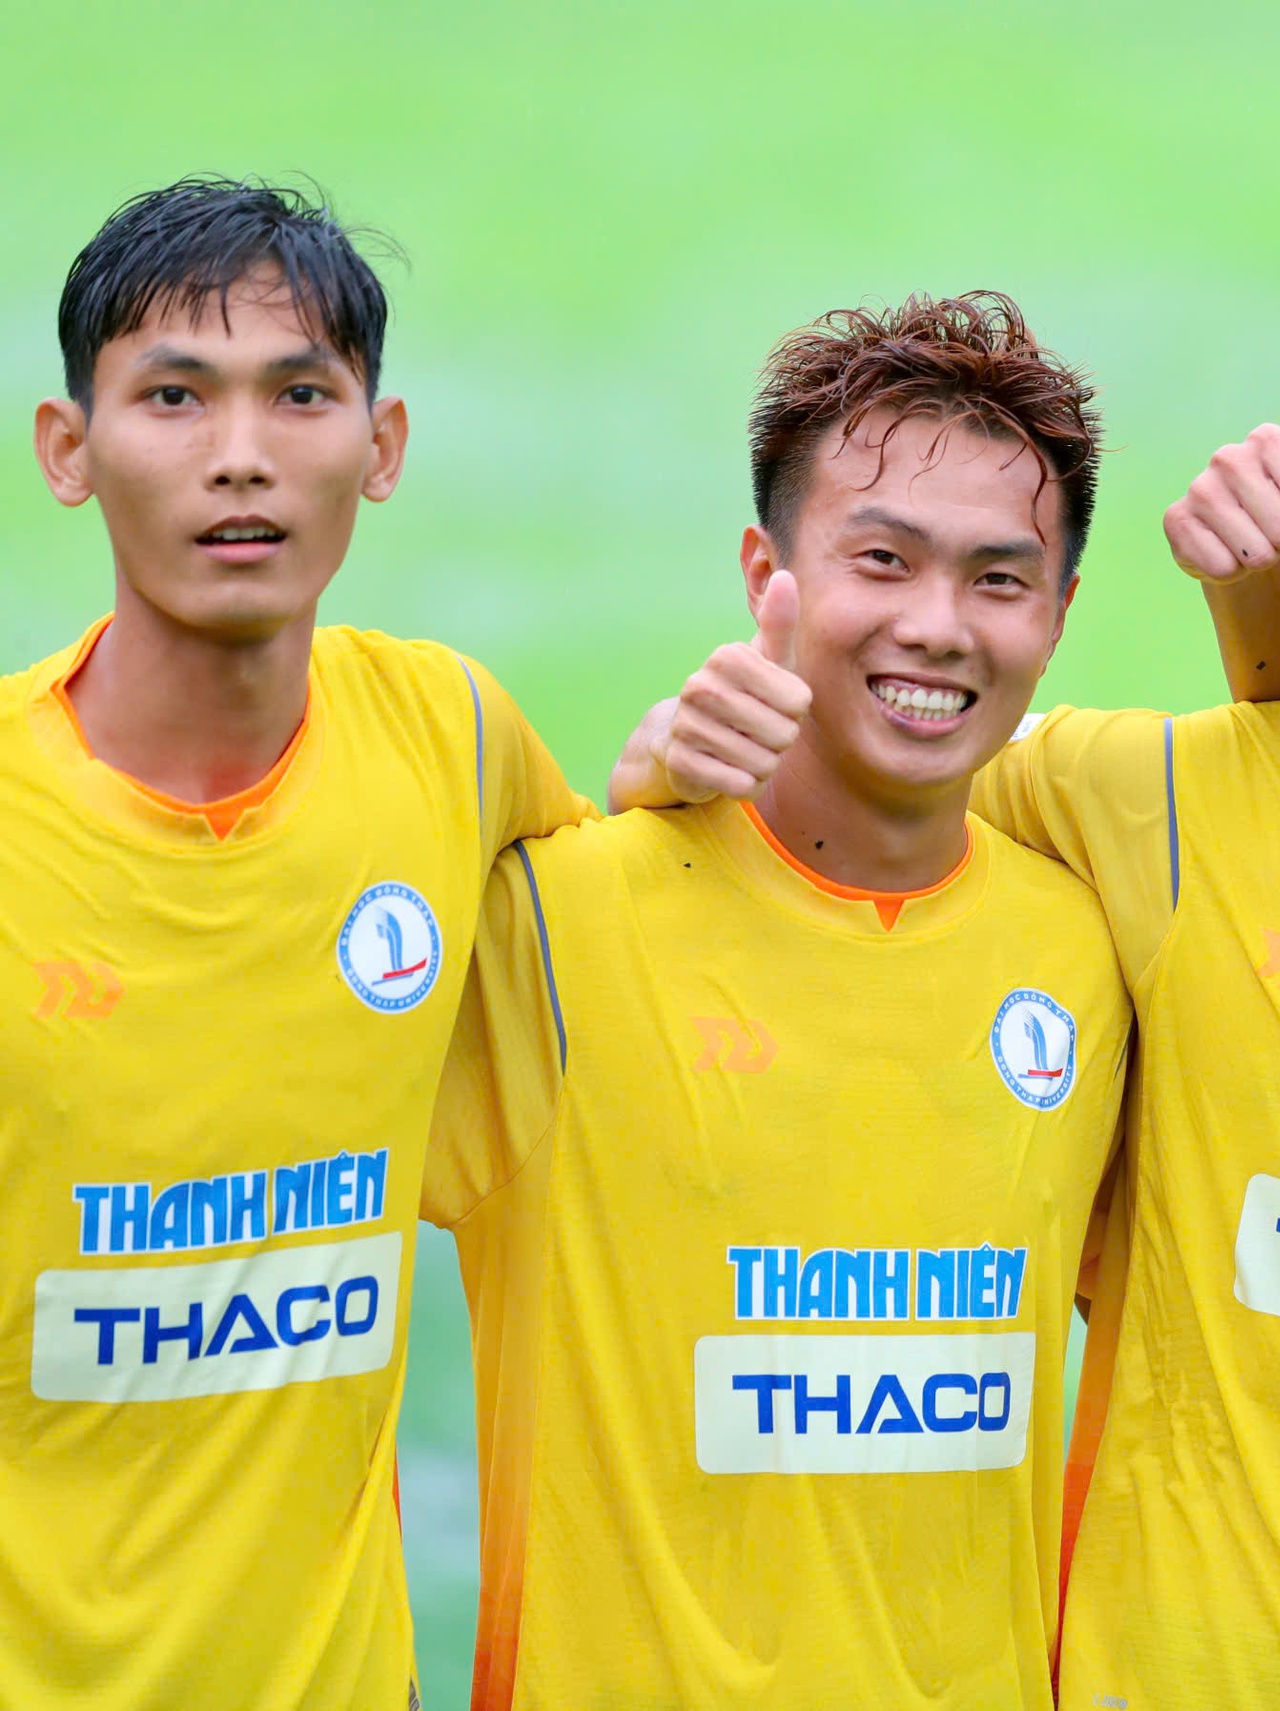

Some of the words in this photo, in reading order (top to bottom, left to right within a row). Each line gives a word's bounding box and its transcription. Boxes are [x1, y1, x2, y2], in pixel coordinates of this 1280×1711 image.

[72, 1168, 268, 1255] THANH
[272, 1148, 389, 1236] NIÊN
[74, 1275, 379, 1365] THACO
[726, 1245, 911, 1321] THANH
[915, 1241, 1028, 1321] NIÊN
[732, 1372, 1011, 1434] THACO
